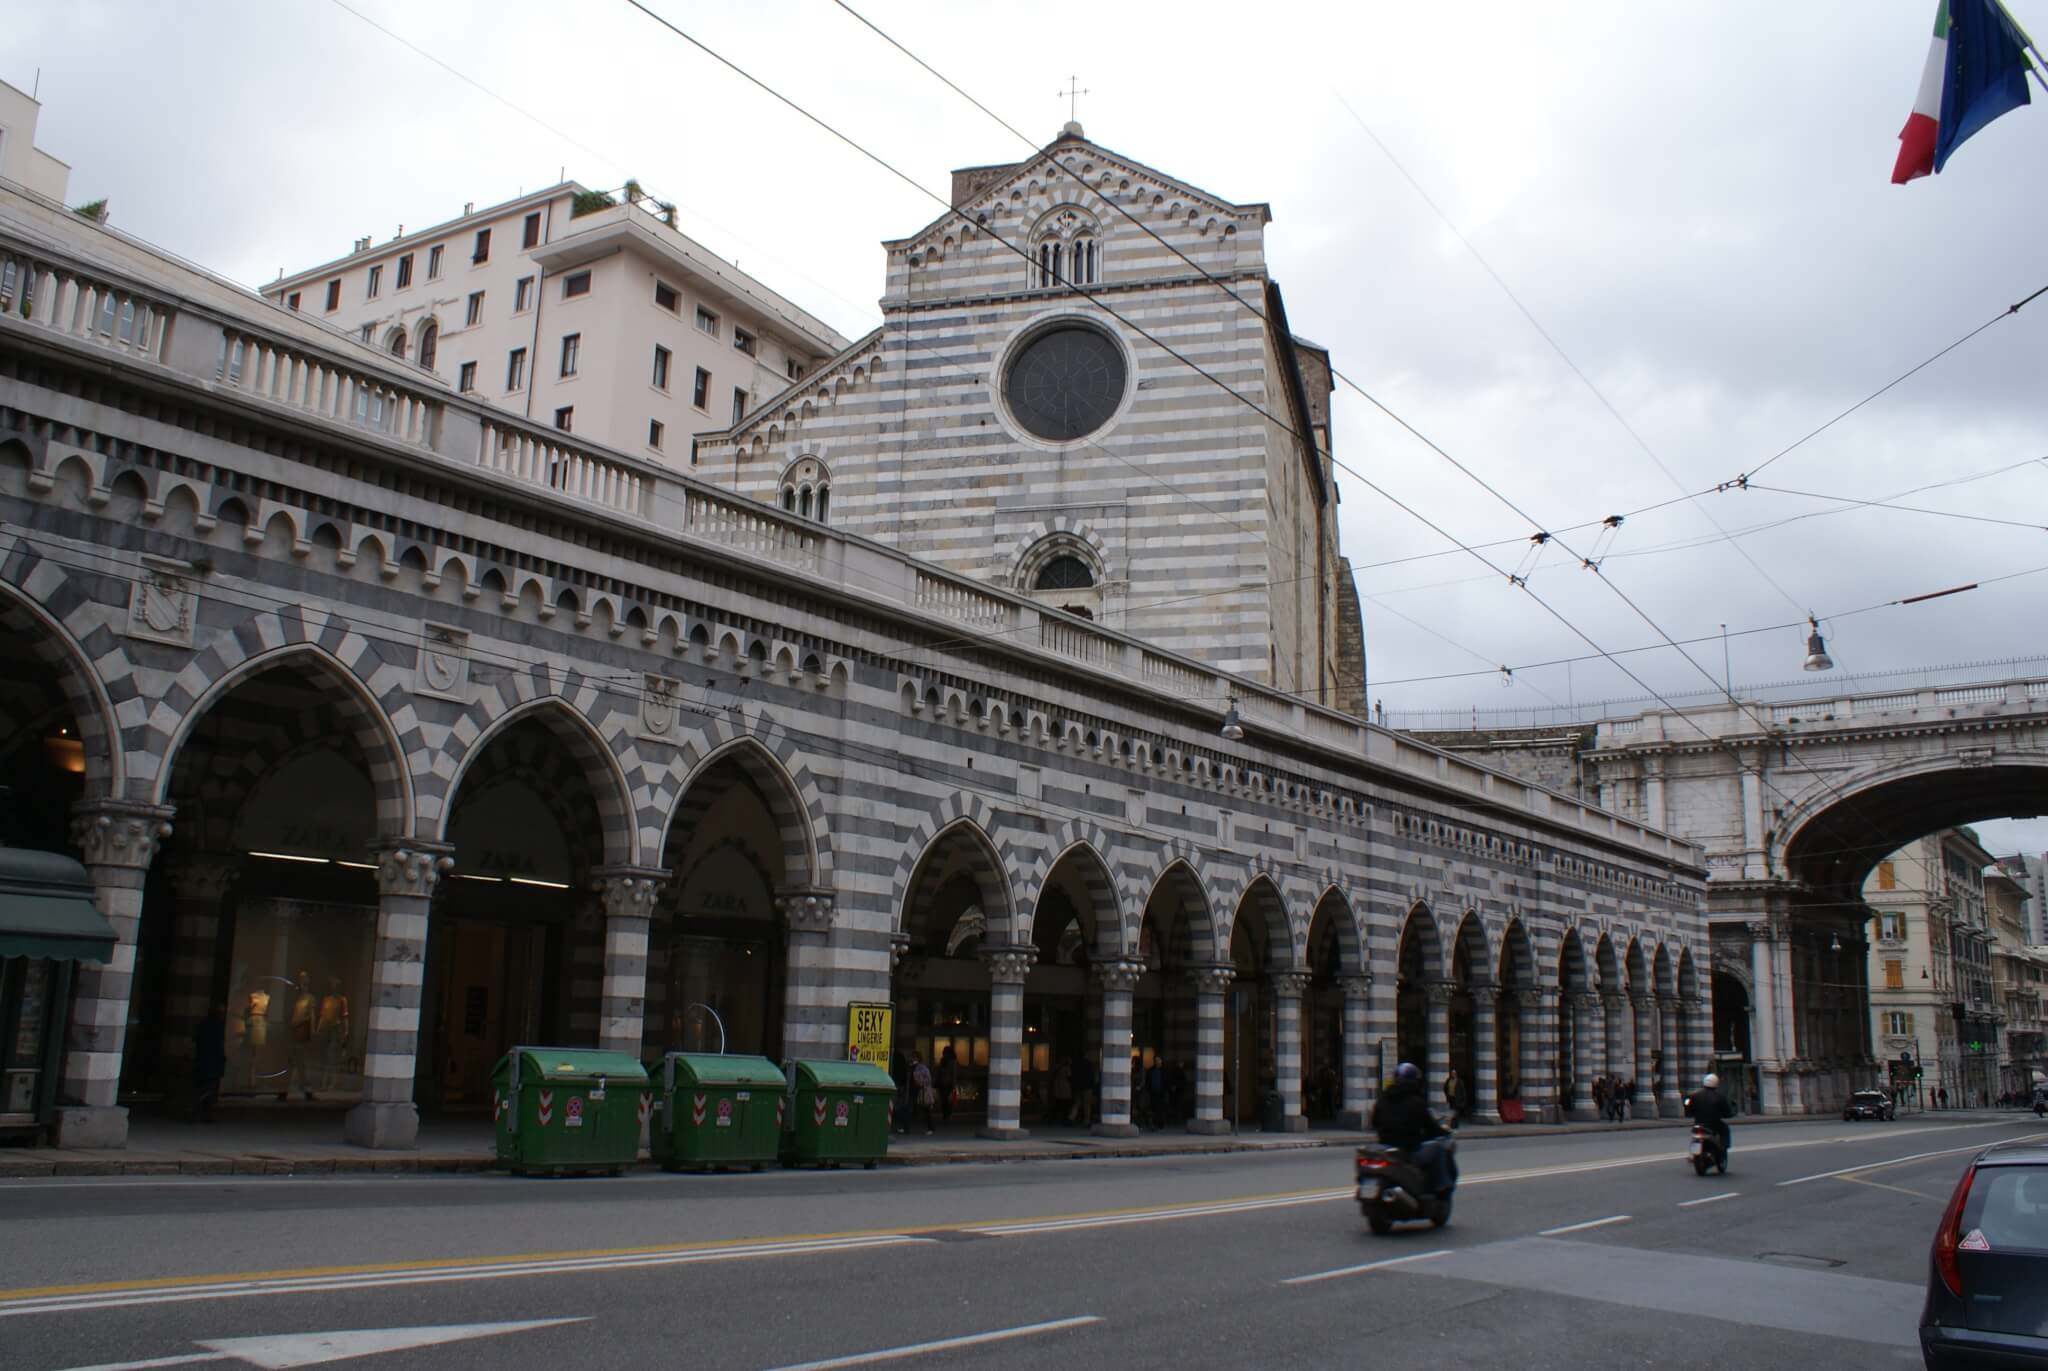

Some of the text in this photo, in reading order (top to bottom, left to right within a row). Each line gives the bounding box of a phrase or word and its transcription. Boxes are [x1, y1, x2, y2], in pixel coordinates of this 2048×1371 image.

[280, 824, 348, 849] ZARA
[480, 849, 535, 874] ZARA
[703, 891, 748, 912] ZARA
[857, 1010, 884, 1032] SEXY
[857, 1032, 883, 1044] LINGERIE
